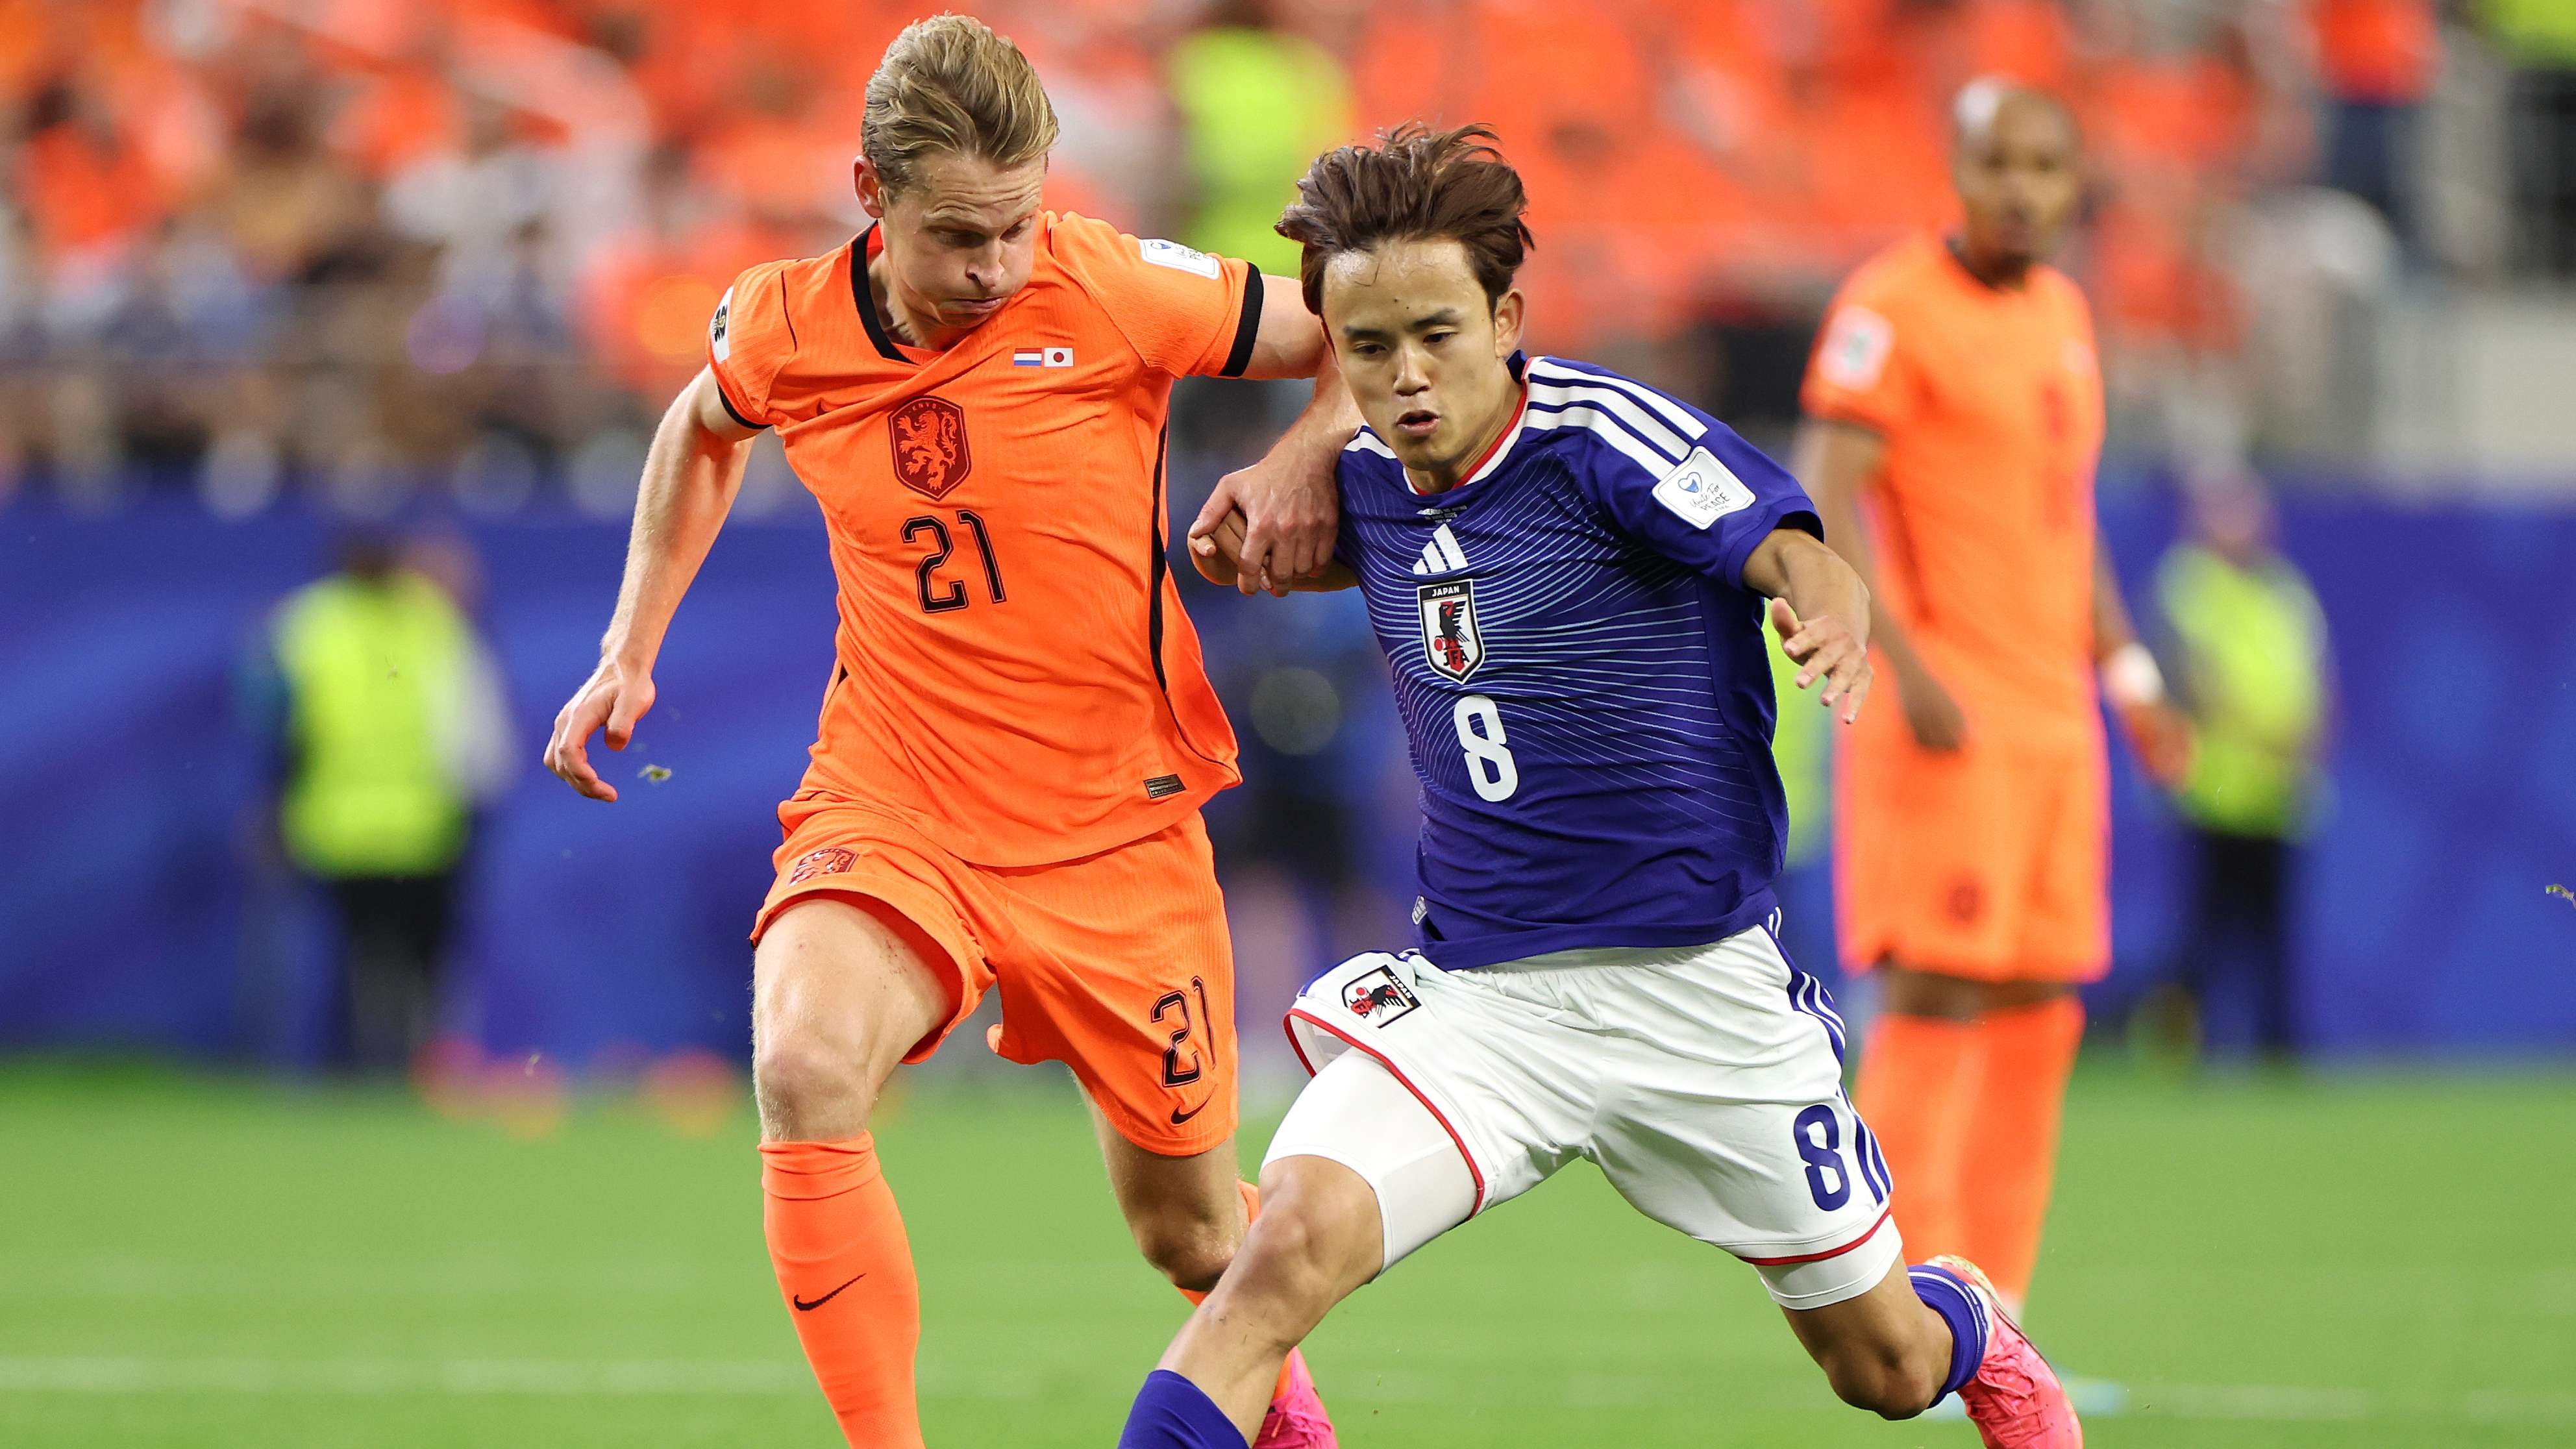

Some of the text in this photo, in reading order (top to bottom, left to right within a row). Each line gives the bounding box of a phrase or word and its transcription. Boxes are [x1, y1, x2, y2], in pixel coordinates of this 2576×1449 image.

[1700, 492, 1731, 511] PEACE
[900, 509, 1007, 613] 21
[1431, 586, 1460, 597] JAPAN
[1443, 650, 1470, 666] JFA
[1454, 694, 1518, 802] 8
[1389, 974, 1413, 999] JAPAN
[1150, 975, 1217, 1087] 21
[1793, 1104, 1851, 1211] 8
